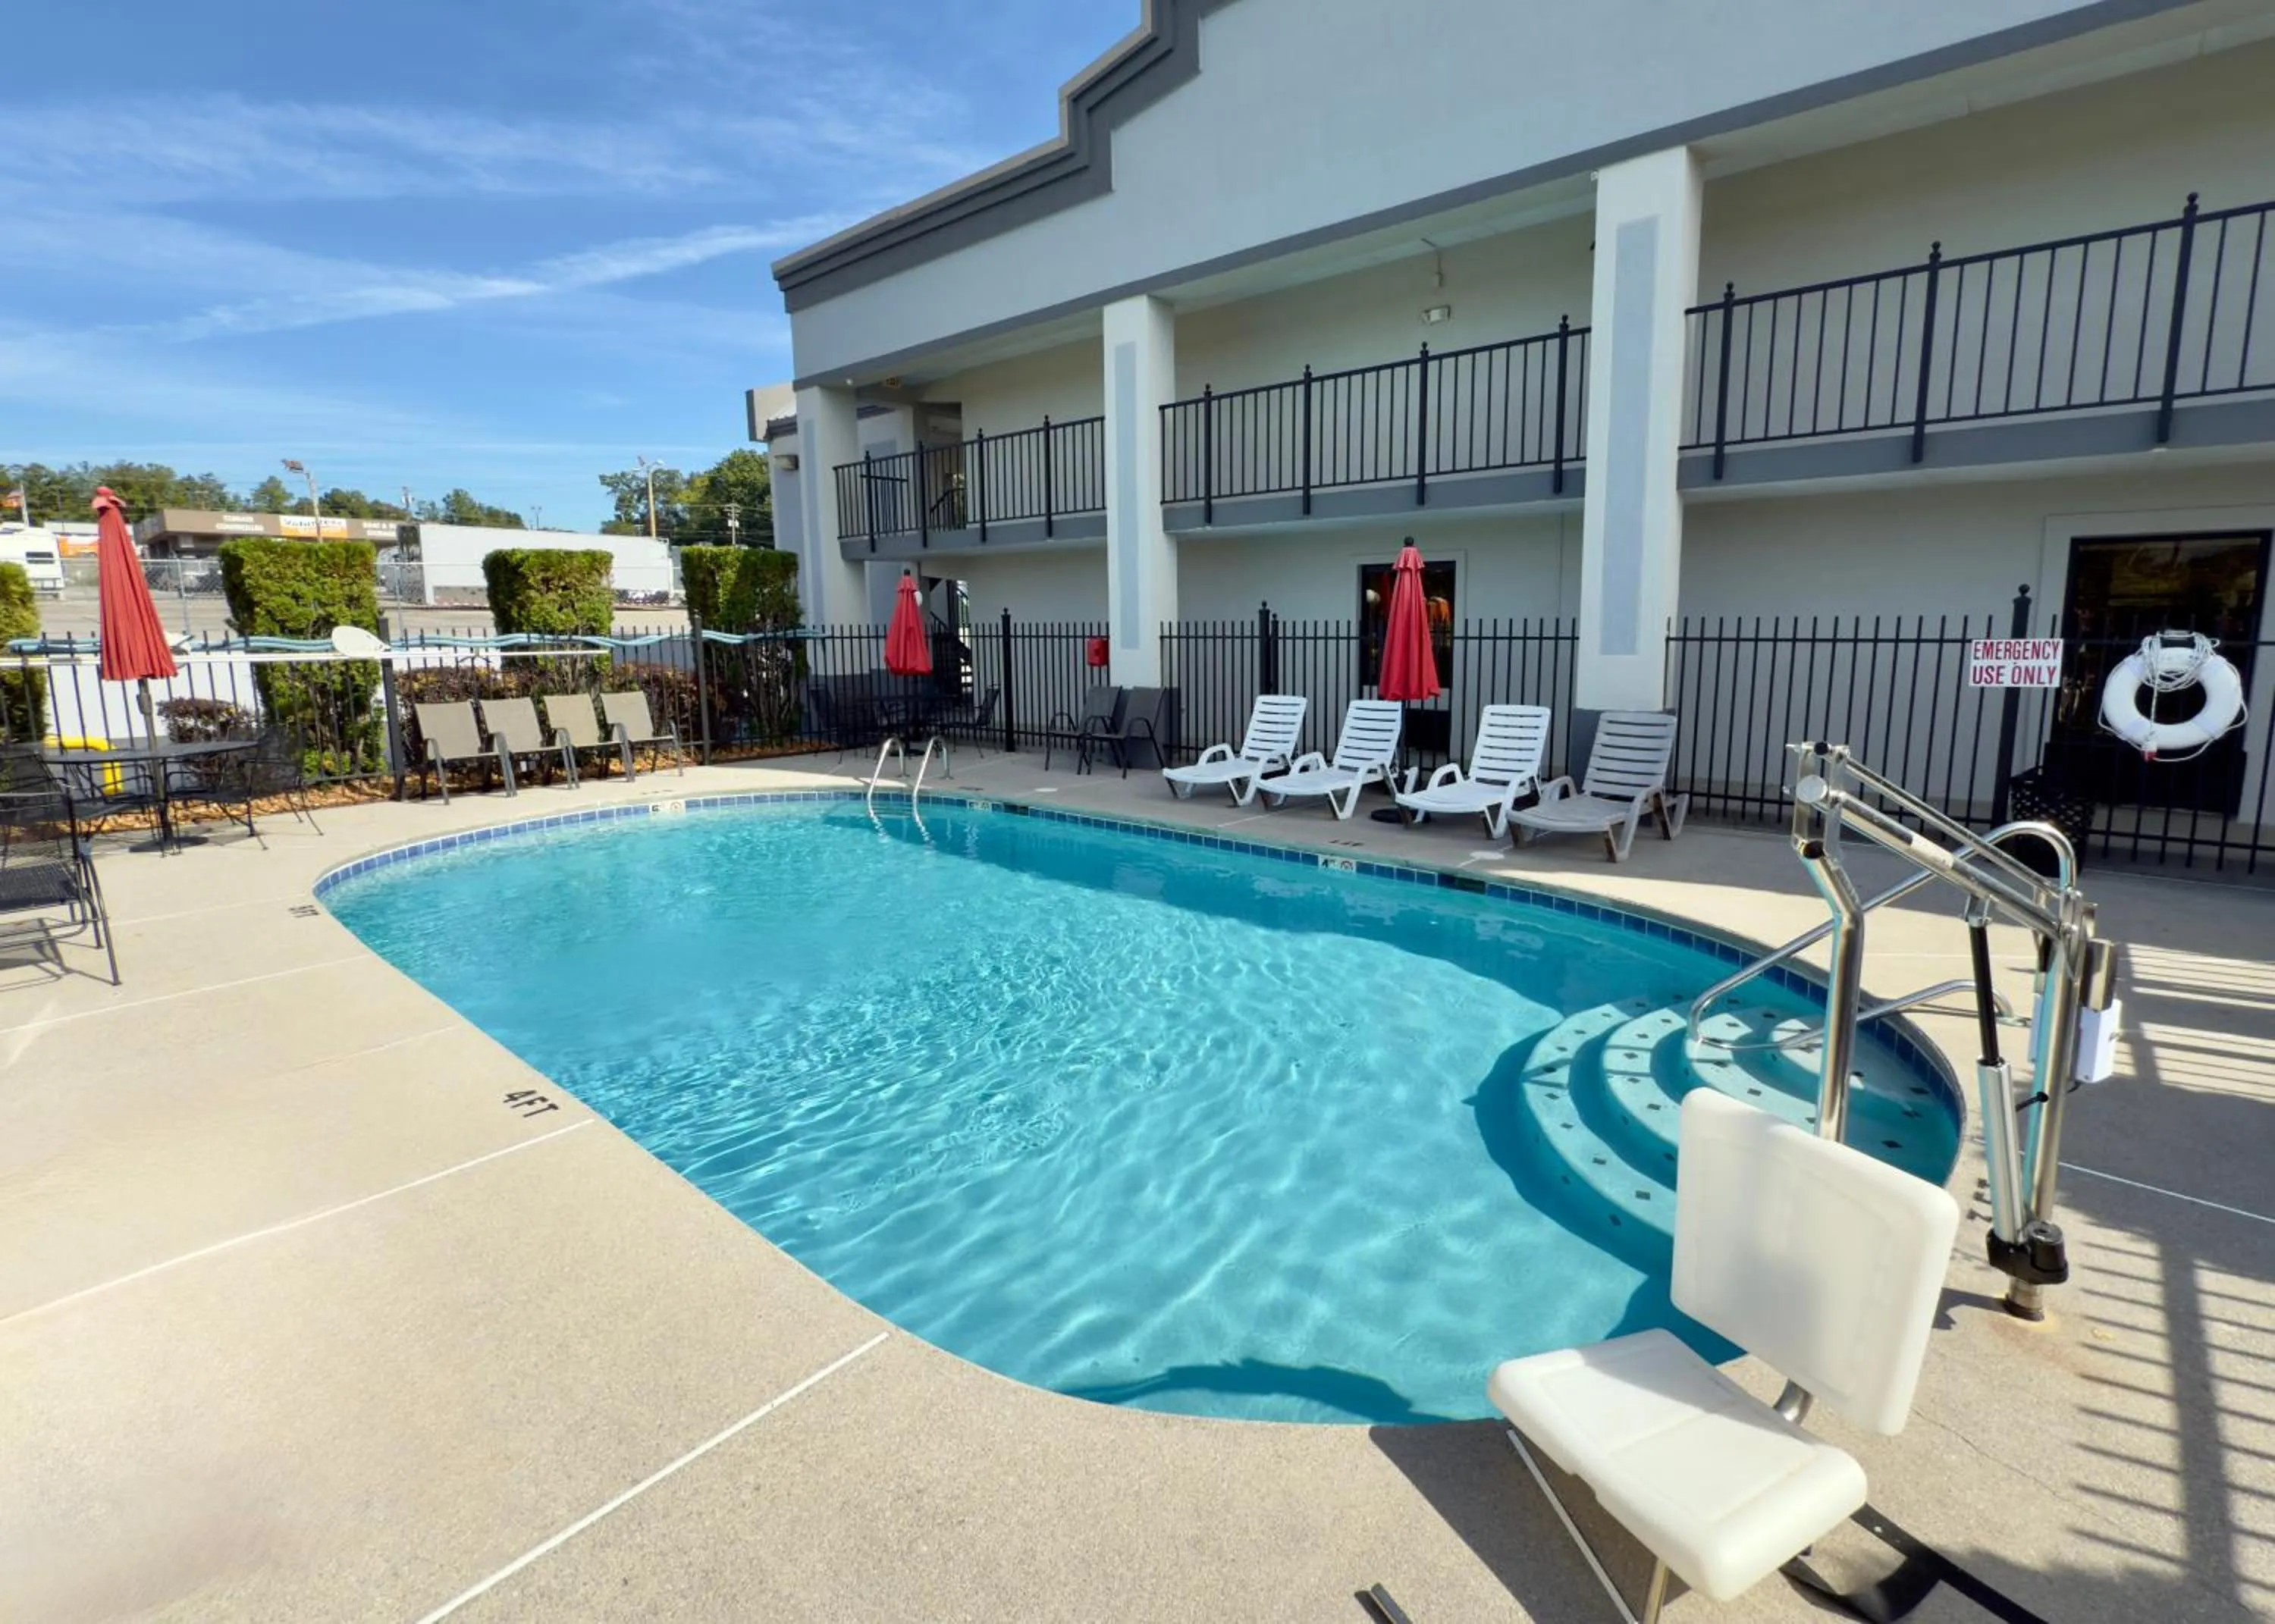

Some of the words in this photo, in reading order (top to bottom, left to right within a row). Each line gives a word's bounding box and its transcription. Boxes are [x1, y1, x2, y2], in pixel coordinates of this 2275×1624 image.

[1973, 641, 2060, 660] EMERGENCY
[1972, 665, 2006, 685] USE
[2011, 665, 2057, 685] ONLY
